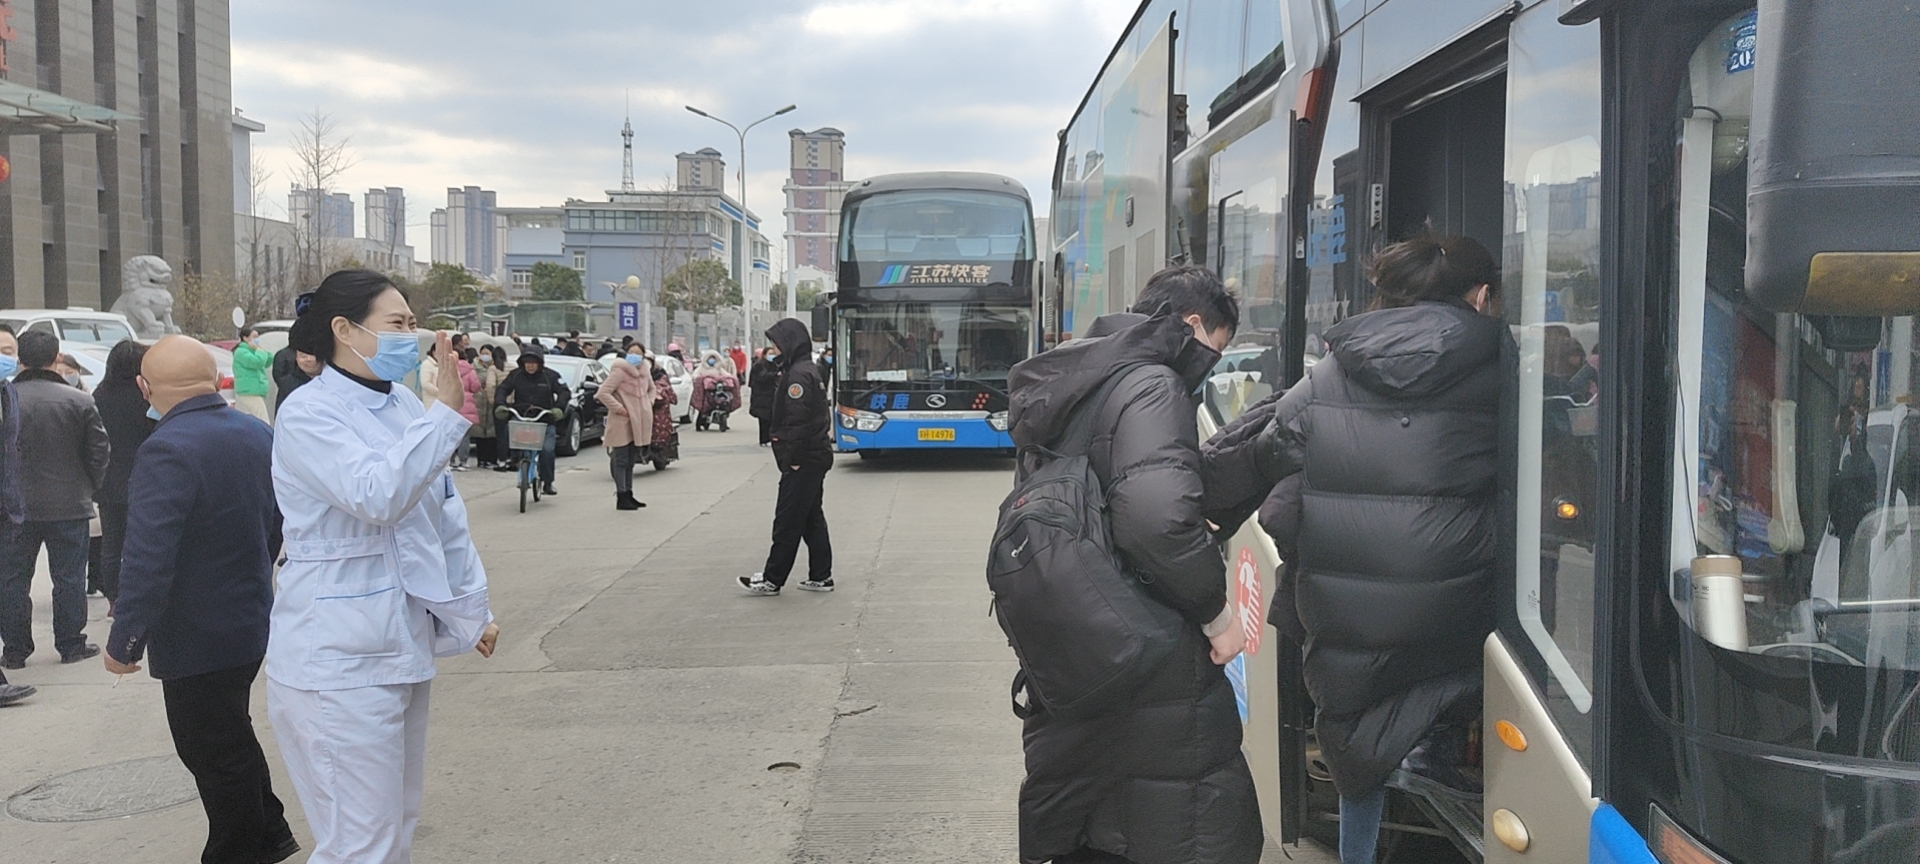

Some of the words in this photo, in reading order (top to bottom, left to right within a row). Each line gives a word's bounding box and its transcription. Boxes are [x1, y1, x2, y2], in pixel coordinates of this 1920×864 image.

[910, 264, 992, 277] 江苏快客
[622, 305, 635, 327] 进口
[869, 393, 910, 410] 快鹿
